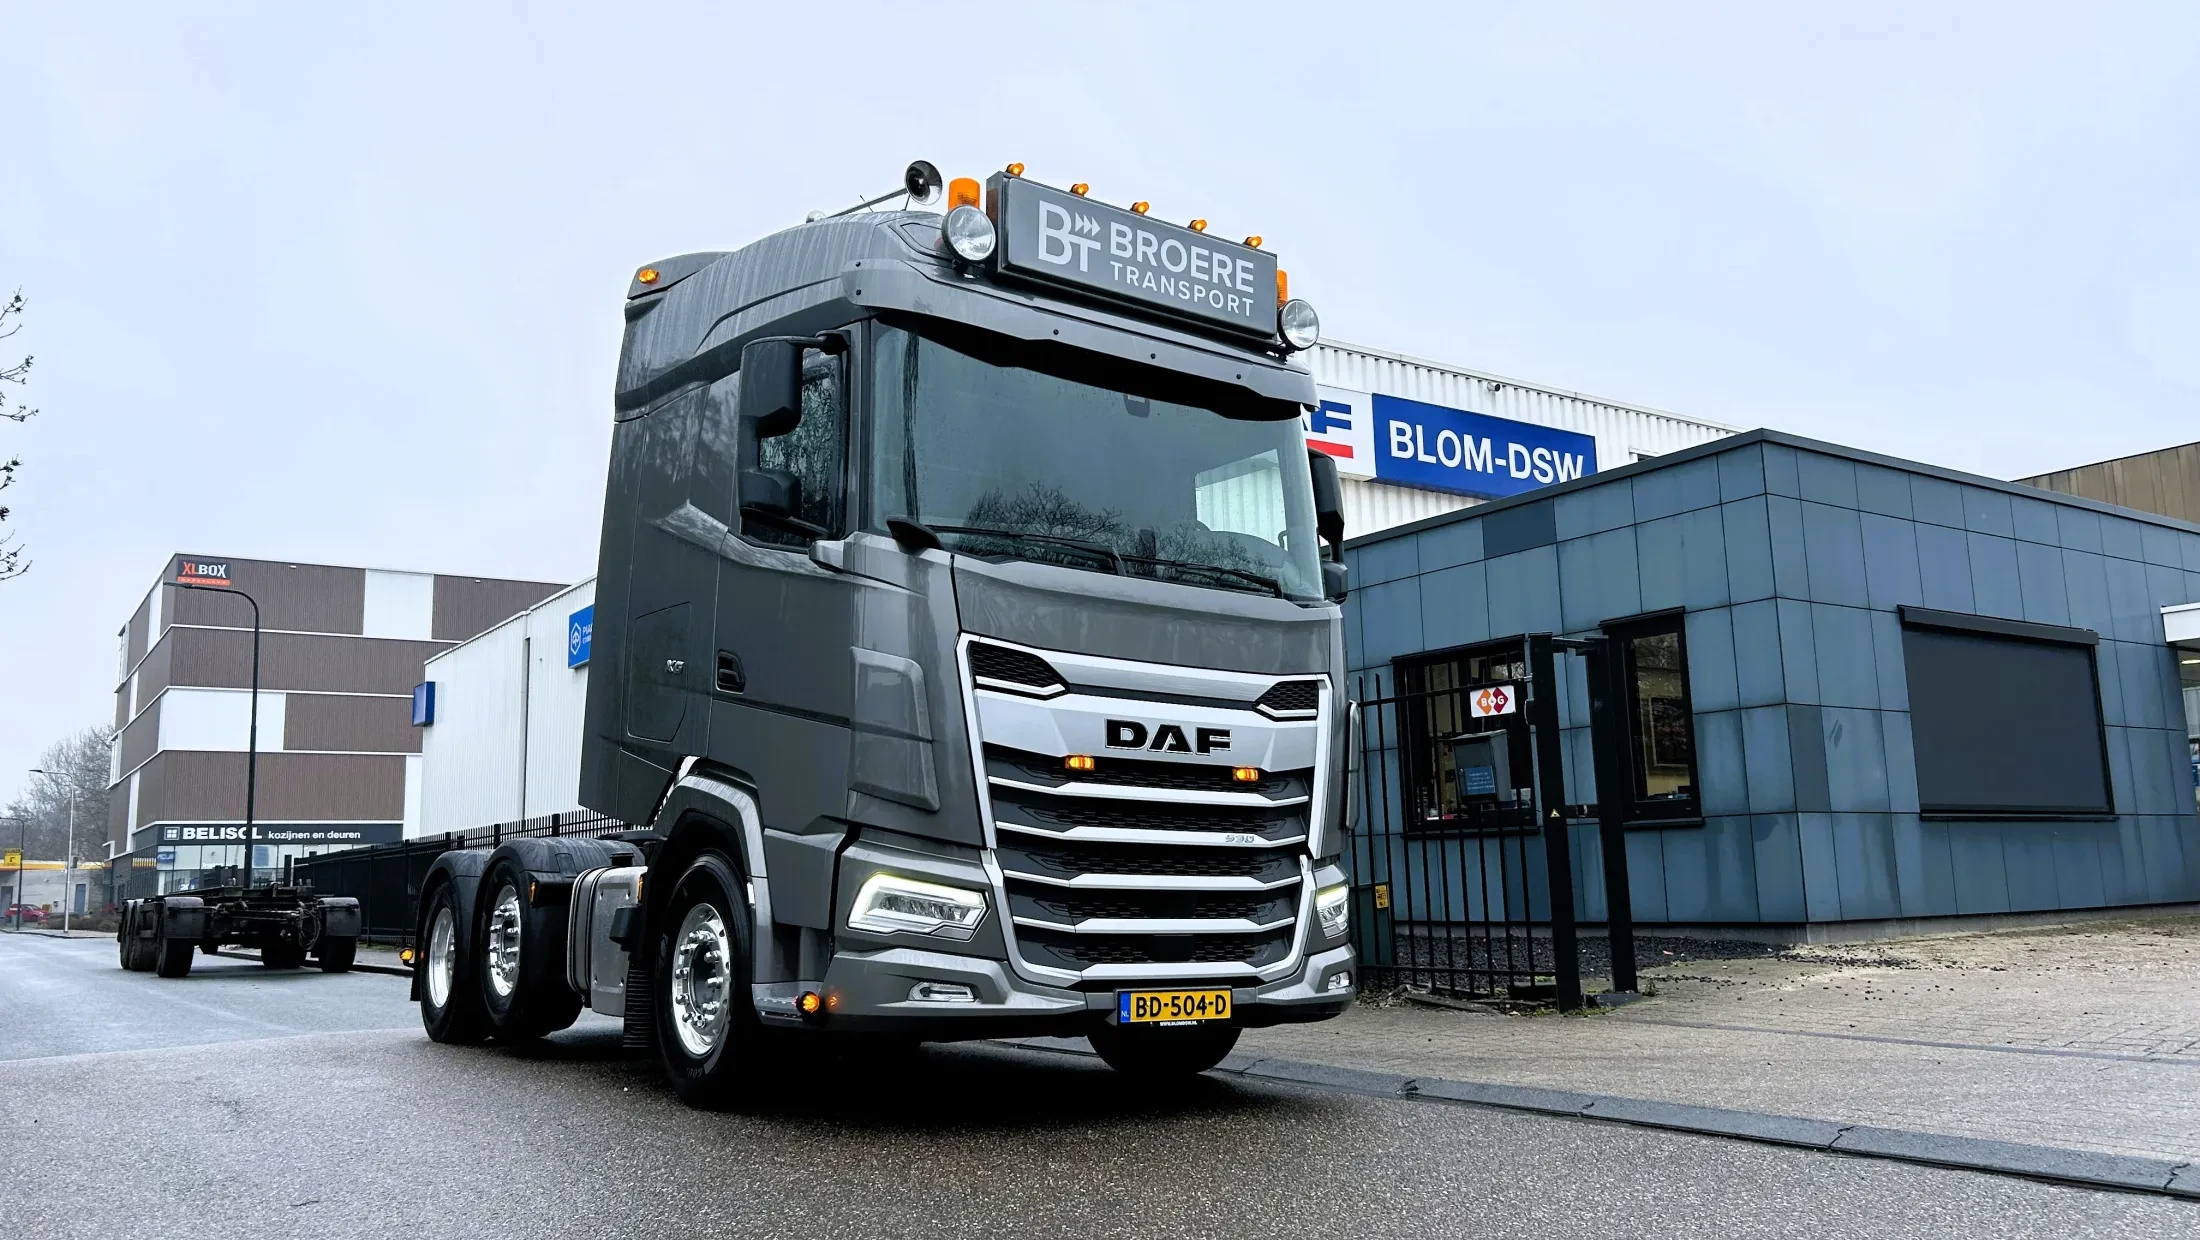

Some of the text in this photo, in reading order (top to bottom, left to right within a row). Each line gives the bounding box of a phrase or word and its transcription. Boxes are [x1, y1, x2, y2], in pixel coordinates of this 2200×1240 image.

[1110, 221, 1254, 294] BROERE
[1110, 260, 1254, 317] TRANSPORT
[1389, 419, 1584, 484] BLOM-DSW
[182, 561, 227, 578] XLBOX
[1104, 718, 1232, 756] DAF
[268, 831, 310, 841] kozijnen
[312, 831, 325, 839] en
[327, 831, 361, 839] deuren
[1120, 1010, 1129, 1018] NL
[1135, 994, 1226, 1018] BD-504-D
